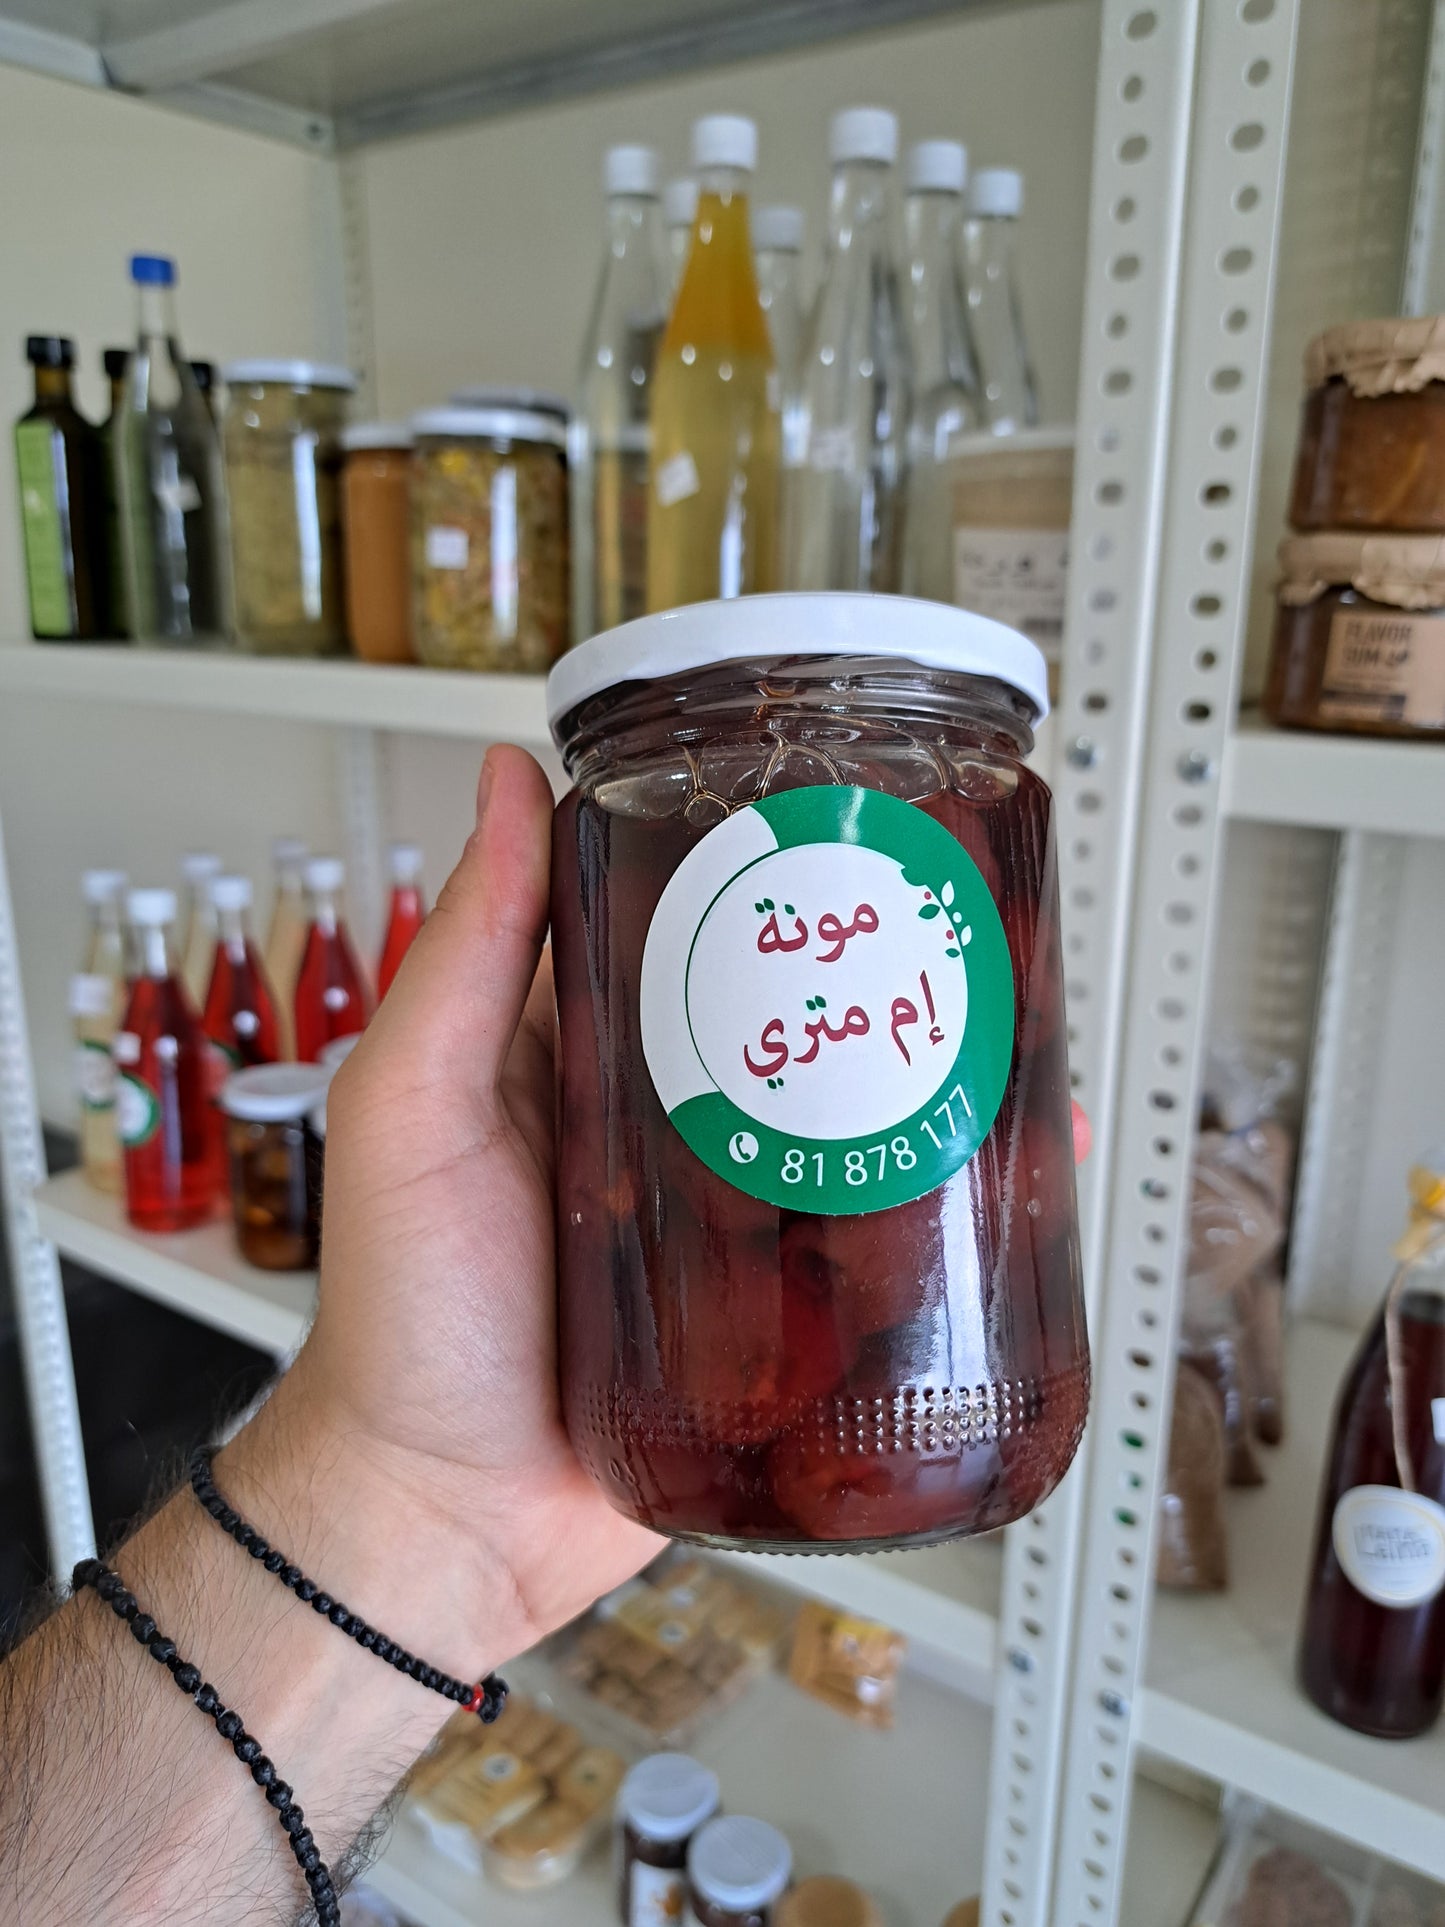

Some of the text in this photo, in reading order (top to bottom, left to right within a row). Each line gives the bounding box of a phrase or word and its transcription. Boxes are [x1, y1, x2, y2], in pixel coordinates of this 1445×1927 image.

[754, 897, 880, 963] مونة
[743, 969, 946, 1090] إم متري
[780, 1083, 973, 1187] 81 878 177
